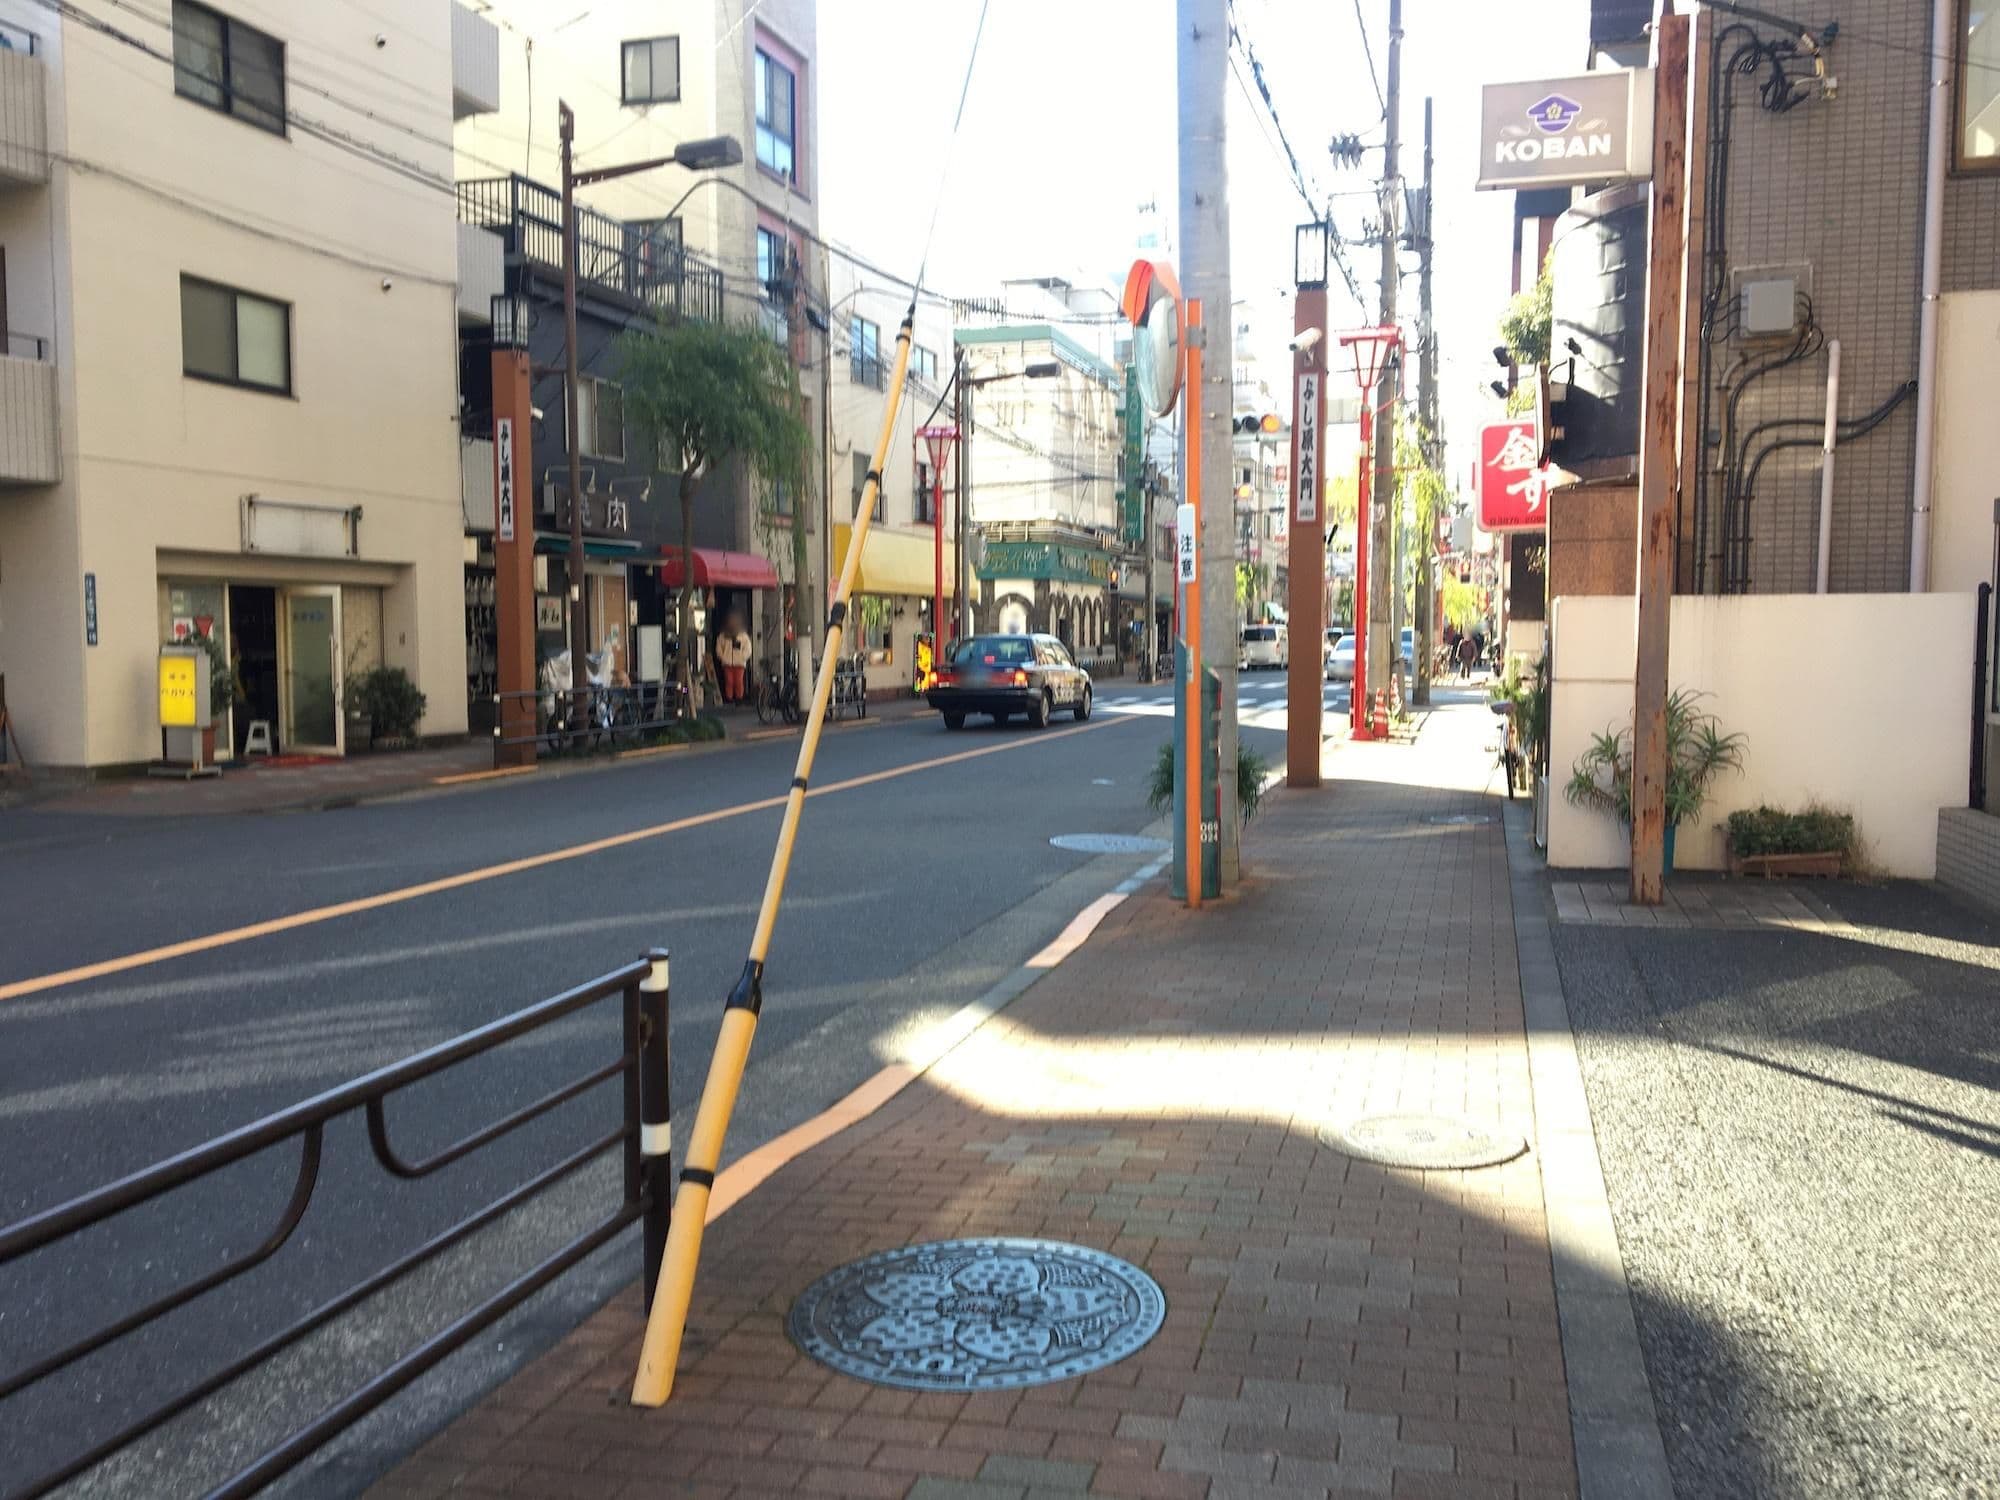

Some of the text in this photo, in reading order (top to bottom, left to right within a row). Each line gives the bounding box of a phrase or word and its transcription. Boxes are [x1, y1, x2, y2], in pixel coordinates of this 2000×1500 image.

[1495, 133, 1611, 163] KOBAN
[1300, 377, 1314, 500] よし原大門
[1180, 533, 1192, 577] 注意
